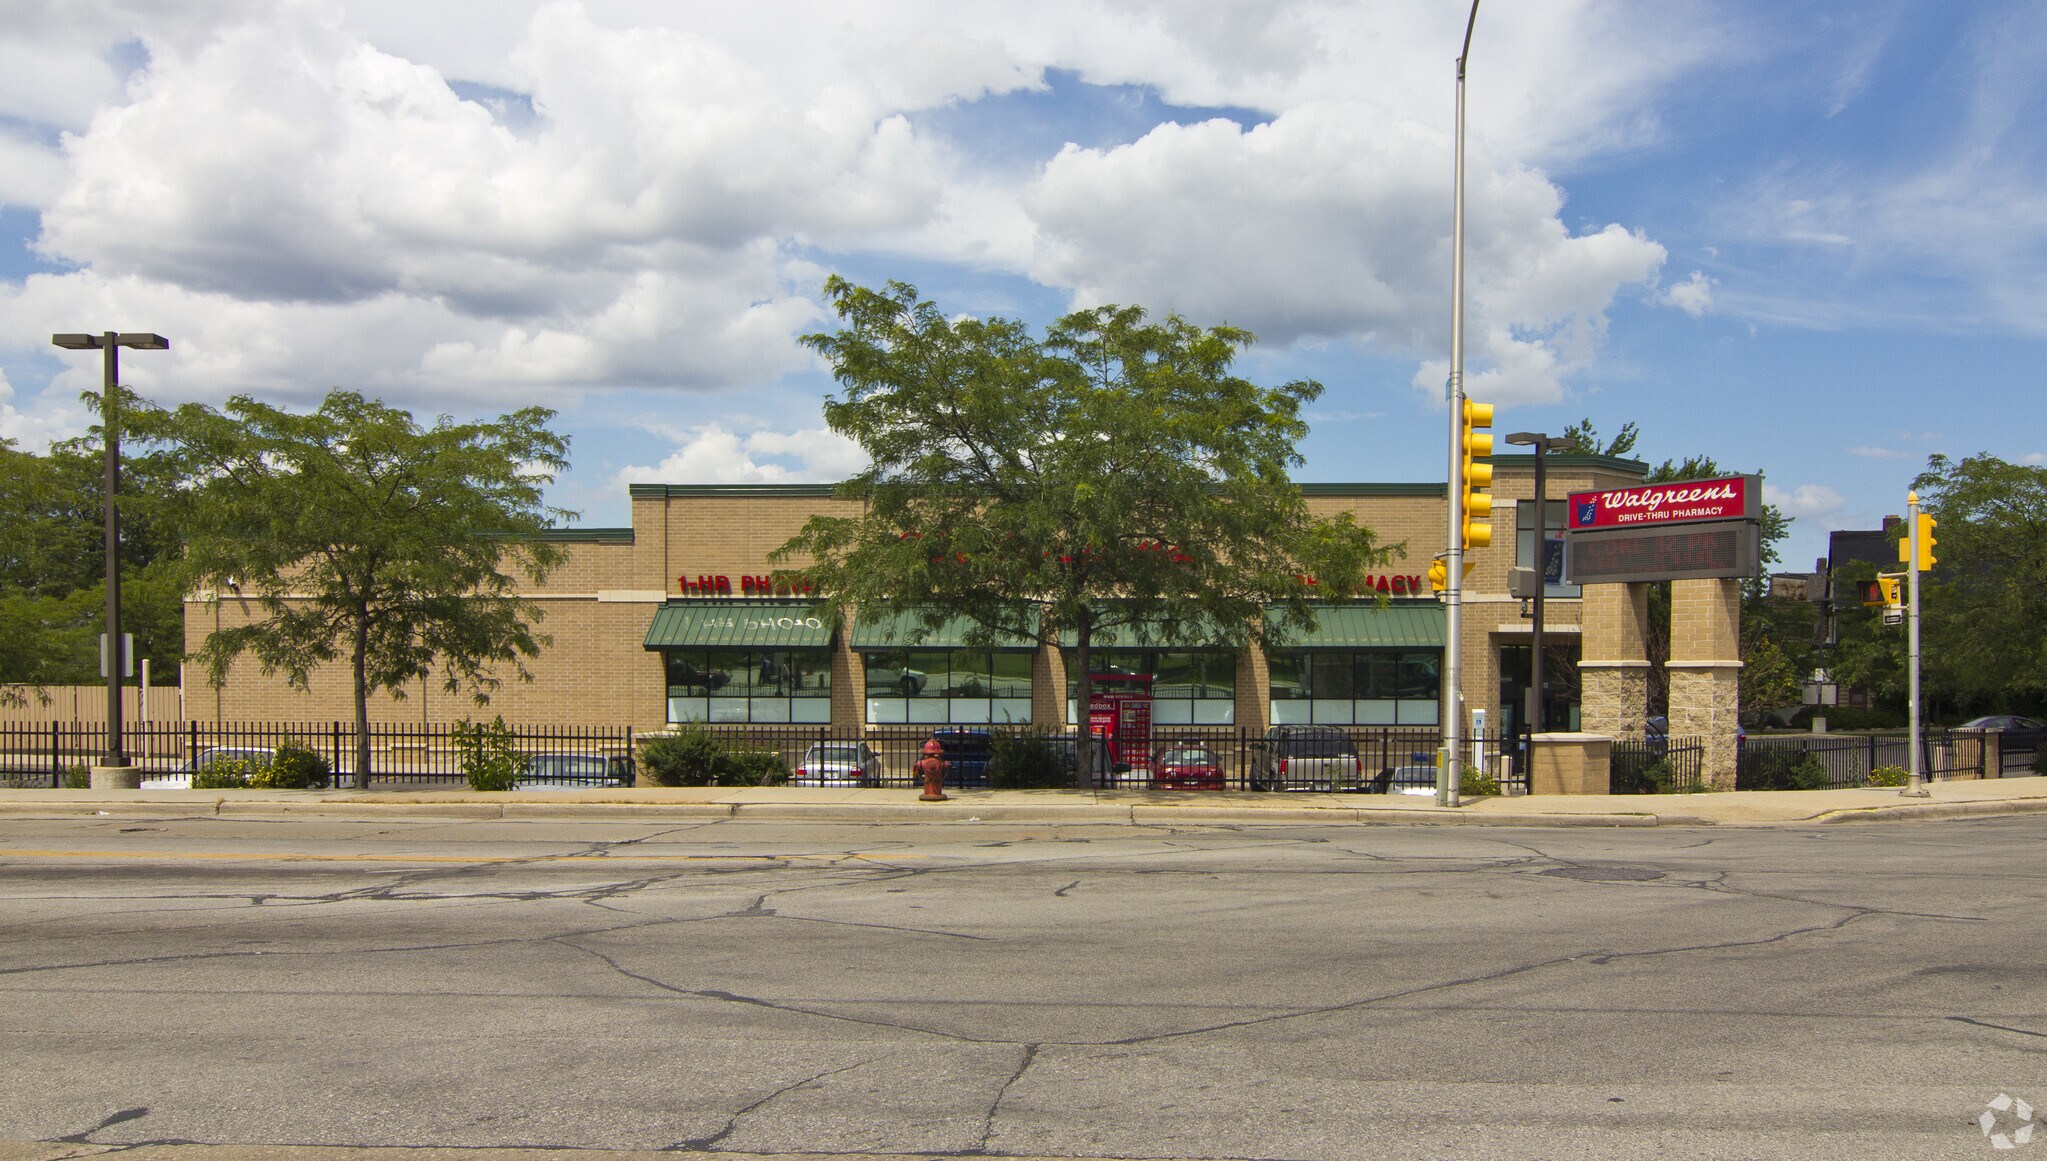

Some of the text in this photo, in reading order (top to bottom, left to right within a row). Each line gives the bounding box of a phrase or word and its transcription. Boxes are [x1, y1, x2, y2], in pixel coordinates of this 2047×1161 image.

[1601, 484, 1737, 511] Walgreens
[1618, 506, 1723, 523] DRIVE-THRU PHARMACY
[677, 575, 729, 592] 1-HR
